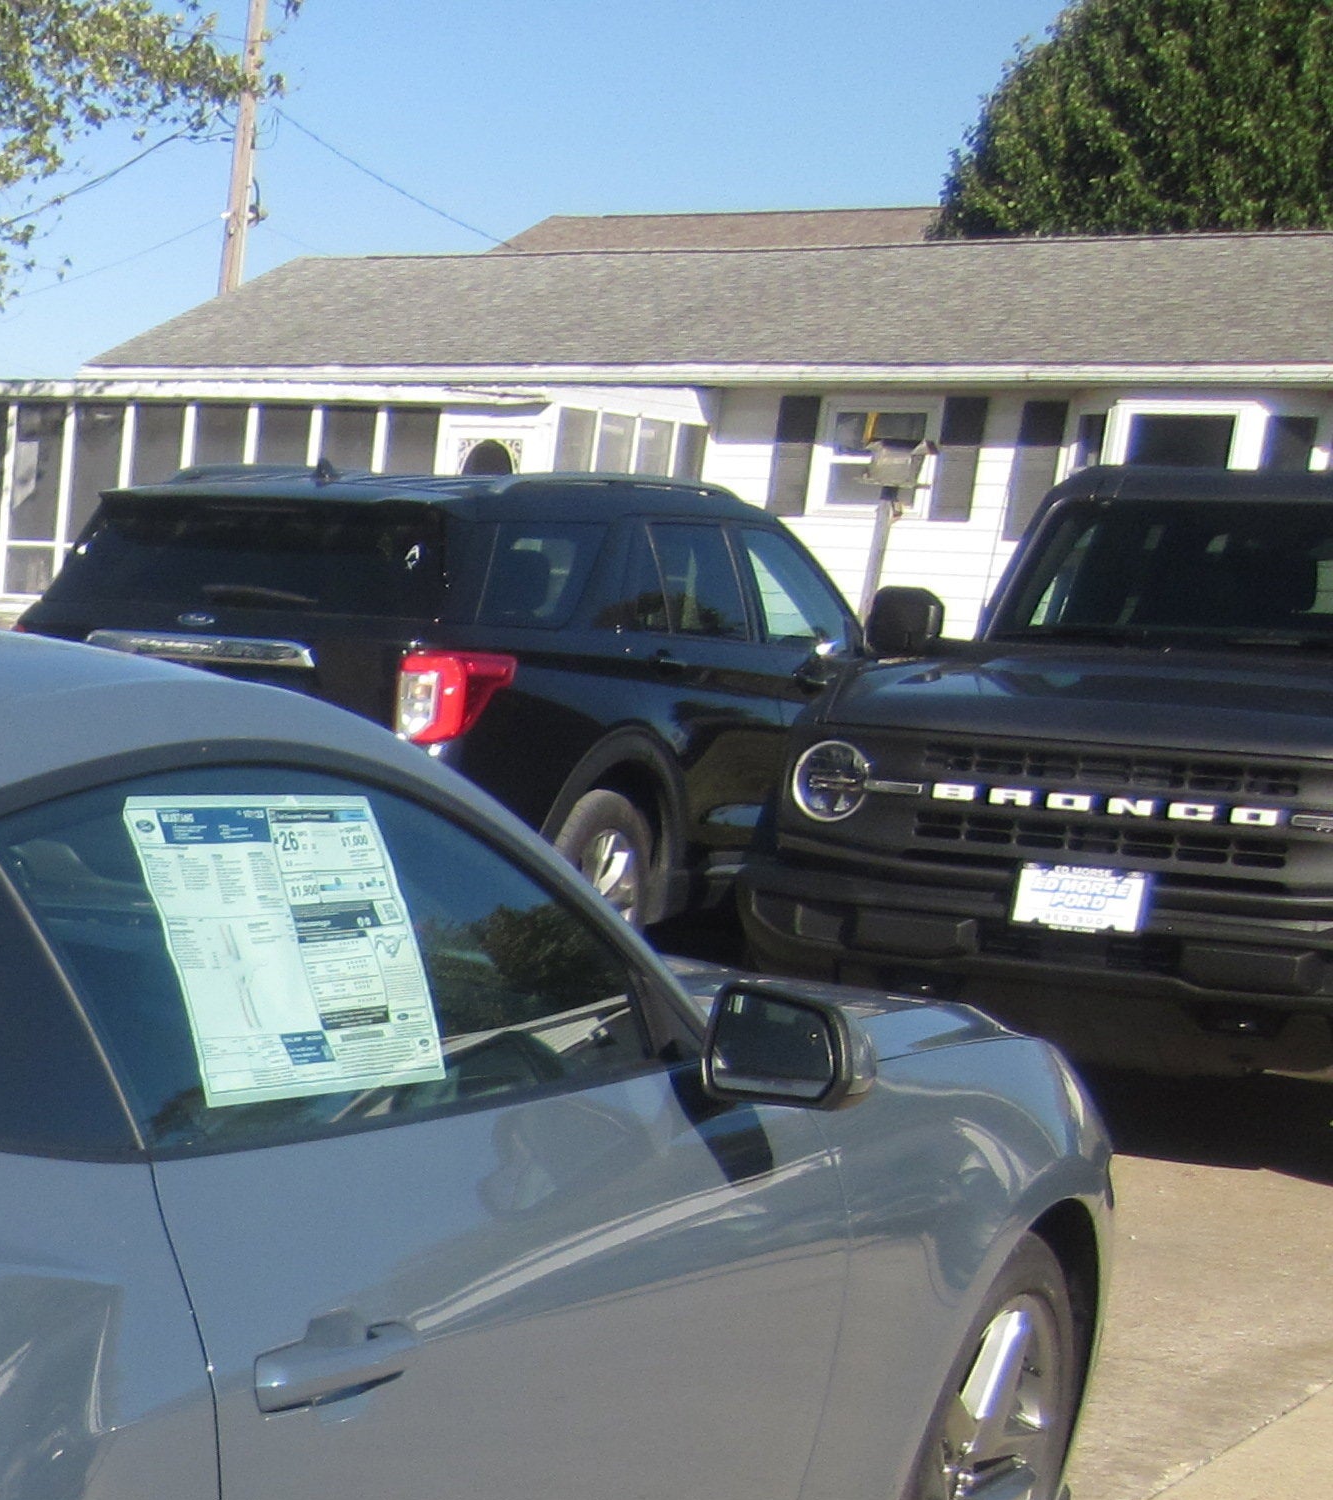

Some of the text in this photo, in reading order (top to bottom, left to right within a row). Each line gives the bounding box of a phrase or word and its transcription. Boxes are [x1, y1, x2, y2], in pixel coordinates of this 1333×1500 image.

[932, 782, 1279, 826] BRONCO
[278, 830, 299, 852] 26
[1054, 865, 1070, 874] ED
[1031, 876, 1132, 899] ED MORSE
[1050, 892, 1108, 911] FORD
